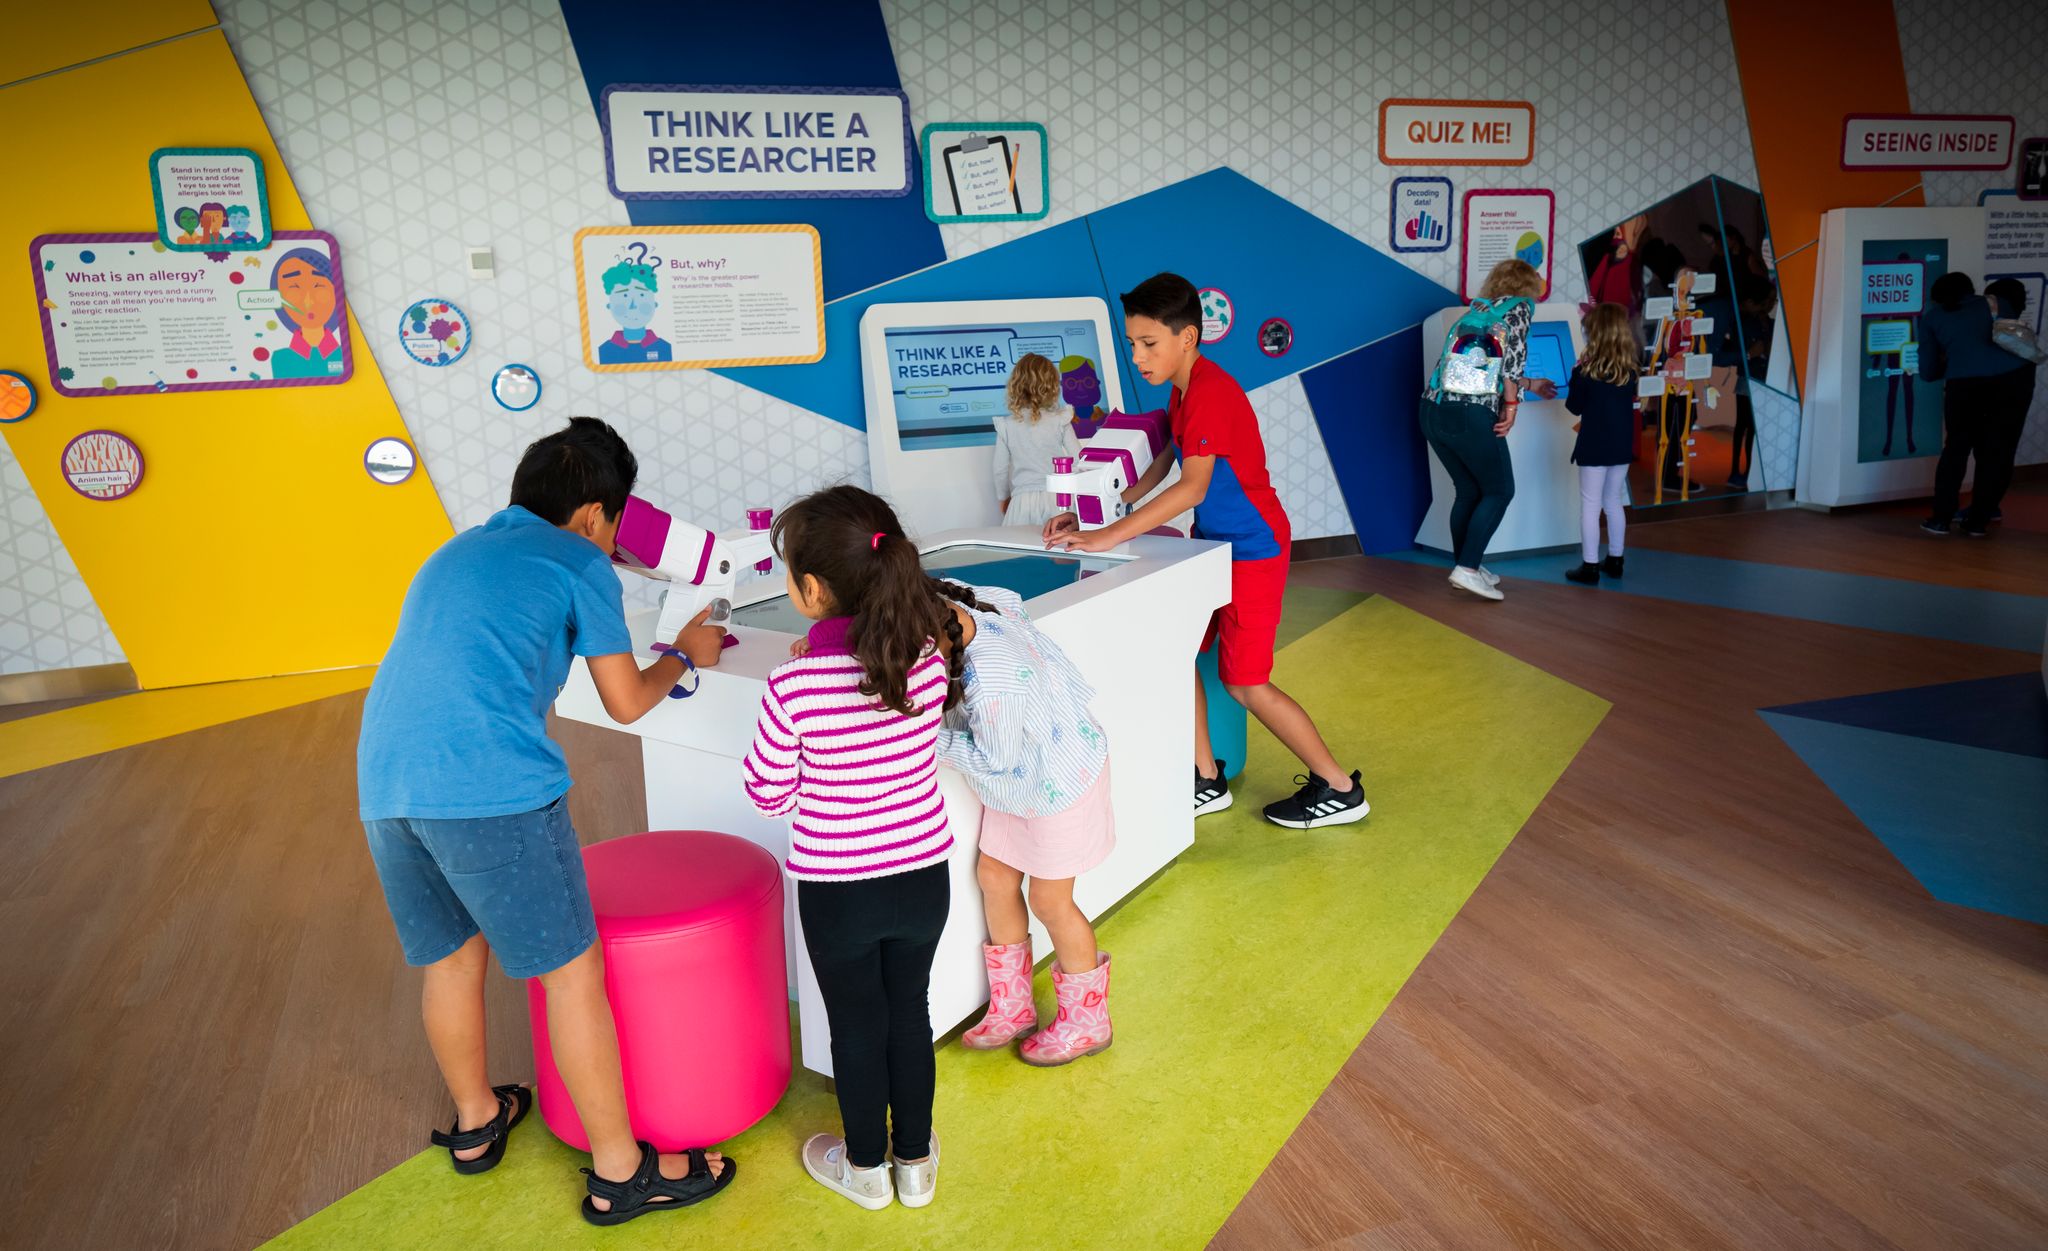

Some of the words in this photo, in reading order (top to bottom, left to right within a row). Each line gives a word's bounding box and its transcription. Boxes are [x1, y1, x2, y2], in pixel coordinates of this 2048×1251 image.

[643, 110, 755, 139] THINK
[764, 111, 835, 139] LIKE
[845, 112, 870, 139] A
[1407, 120, 1465, 144] QUIZ
[1472, 121, 1511, 144] ME!
[1863, 132, 1932, 152] SEEING
[1937, 132, 1998, 152] INSIDE
[647, 146, 876, 174] RESEARCHER
[983, 168, 998, 177] what?
[985, 179, 998, 188] why?
[1406, 189, 1440, 199] Decoding
[1414, 198, 1431, 207] data!
[670, 259, 694, 270] But,
[697, 258, 726, 271] why?
[65, 271, 106, 283] What
[110, 271, 122, 282] is
[127, 273, 144, 282] an
[149, 269, 205, 283] allergy?
[710, 274, 738, 282] greatest
[739, 274, 760, 282] power
[1868, 273, 1913, 288] SEEING
[68, 290, 111, 299] Sneezing,
[143, 289, 163, 297] eyes
[190, 288, 214, 296] runny
[1868, 289, 1910, 304] INSIDE
[148, 297, 175, 305] you're
[176, 296, 205, 304] having
[247, 296, 275, 304] Achoo!
[71, 307, 102, 316] allergic
[104, 305, 142, 314] reaction.
[895, 347, 948, 362] THINK
[951, 346, 985, 360] LIKE
[990, 345, 1002, 358] A
[898, 361, 1007, 379] RESEARCHER
[77, 476, 105, 484] Animal
